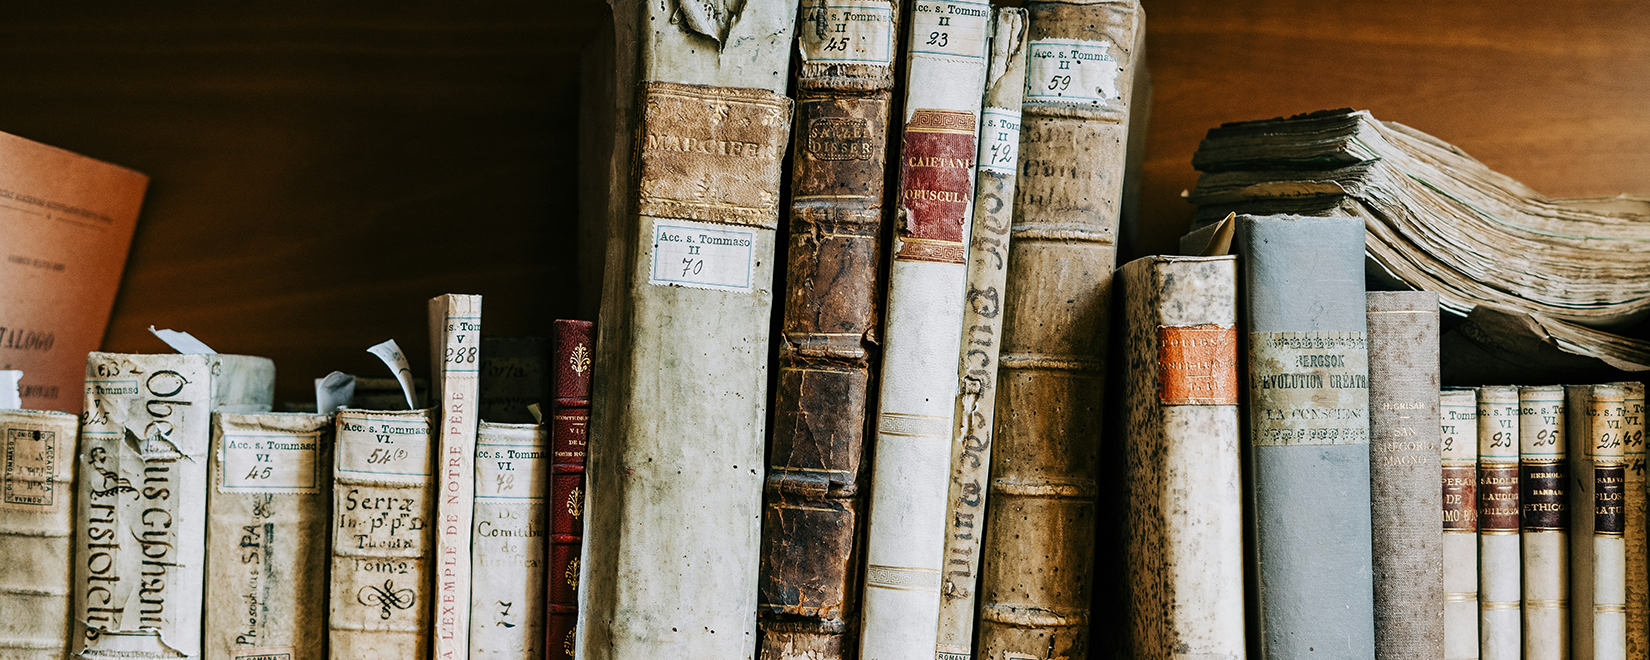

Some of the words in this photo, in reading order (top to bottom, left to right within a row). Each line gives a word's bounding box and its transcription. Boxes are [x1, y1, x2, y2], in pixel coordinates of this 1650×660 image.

[831, 13, 840, 21] s.
[938, 16, 951, 26] II
[835, 23, 847, 33] II
[824, 37, 850, 52] 45
[926, 31, 948, 48] 23
[1033, 50, 1055, 59] Acc.
[1058, 51, 1067, 59] s.
[1058, 61, 1070, 70] II
[1048, 75, 1072, 91] 59
[988, 119, 996, 127] s.
[998, 132, 1008, 141] II
[991, 143, 1012, 164] 72
[908, 157, 971, 168] CAIETANI
[659, 231, 683, 242] Acc.
[686, 235, 696, 243] s.
[699, 235, 751, 247] Tommaso
[689, 246, 701, 255] II
[682, 257, 704, 277] 70
[456, 334, 466, 344] V
[444, 346, 477, 364] 288
[96, 385, 139, 395] Tommaso
[449, 392, 464, 436] PÈRE
[1493, 409, 1502, 417] s.
[1499, 419, 1514, 429] VI.
[1543, 416, 1559, 425] VI.
[1607, 420, 1622, 429] VI.
[1625, 416, 1642, 425] VI.
[343, 422, 365, 433] Acc.
[369, 425, 377, 433] s.
[381, 424, 431, 435] Tommaso
[1394, 426, 1416, 437] SAN
[1441, 425, 1459, 435] VI.
[376, 435, 394, 444] VI.
[1490, 431, 1512, 448] 23
[1533, 429, 1559, 446] 25
[1596, 433, 1620, 449] 24
[1624, 430, 1642, 447] 42
[228, 440, 252, 450] Acc.
[255, 442, 264, 450] s.
[267, 441, 317, 451] Tommaso
[1374, 441, 1434, 453] GREGORIO
[256, 453, 273, 463] VI.
[495, 451, 504, 459] s.
[1384, 455, 1427, 466] MAGNO
[497, 462, 515, 471] VI.
[245, 466, 274, 480] 45
[447, 446, 462, 505] NOTRE
[1446, 494, 1462, 505] DE
[497, 508, 518, 520] De
[446, 514, 459, 535] DE
[501, 541, 518, 553] de
[442, 546, 457, 640] L'EXEMPLE
